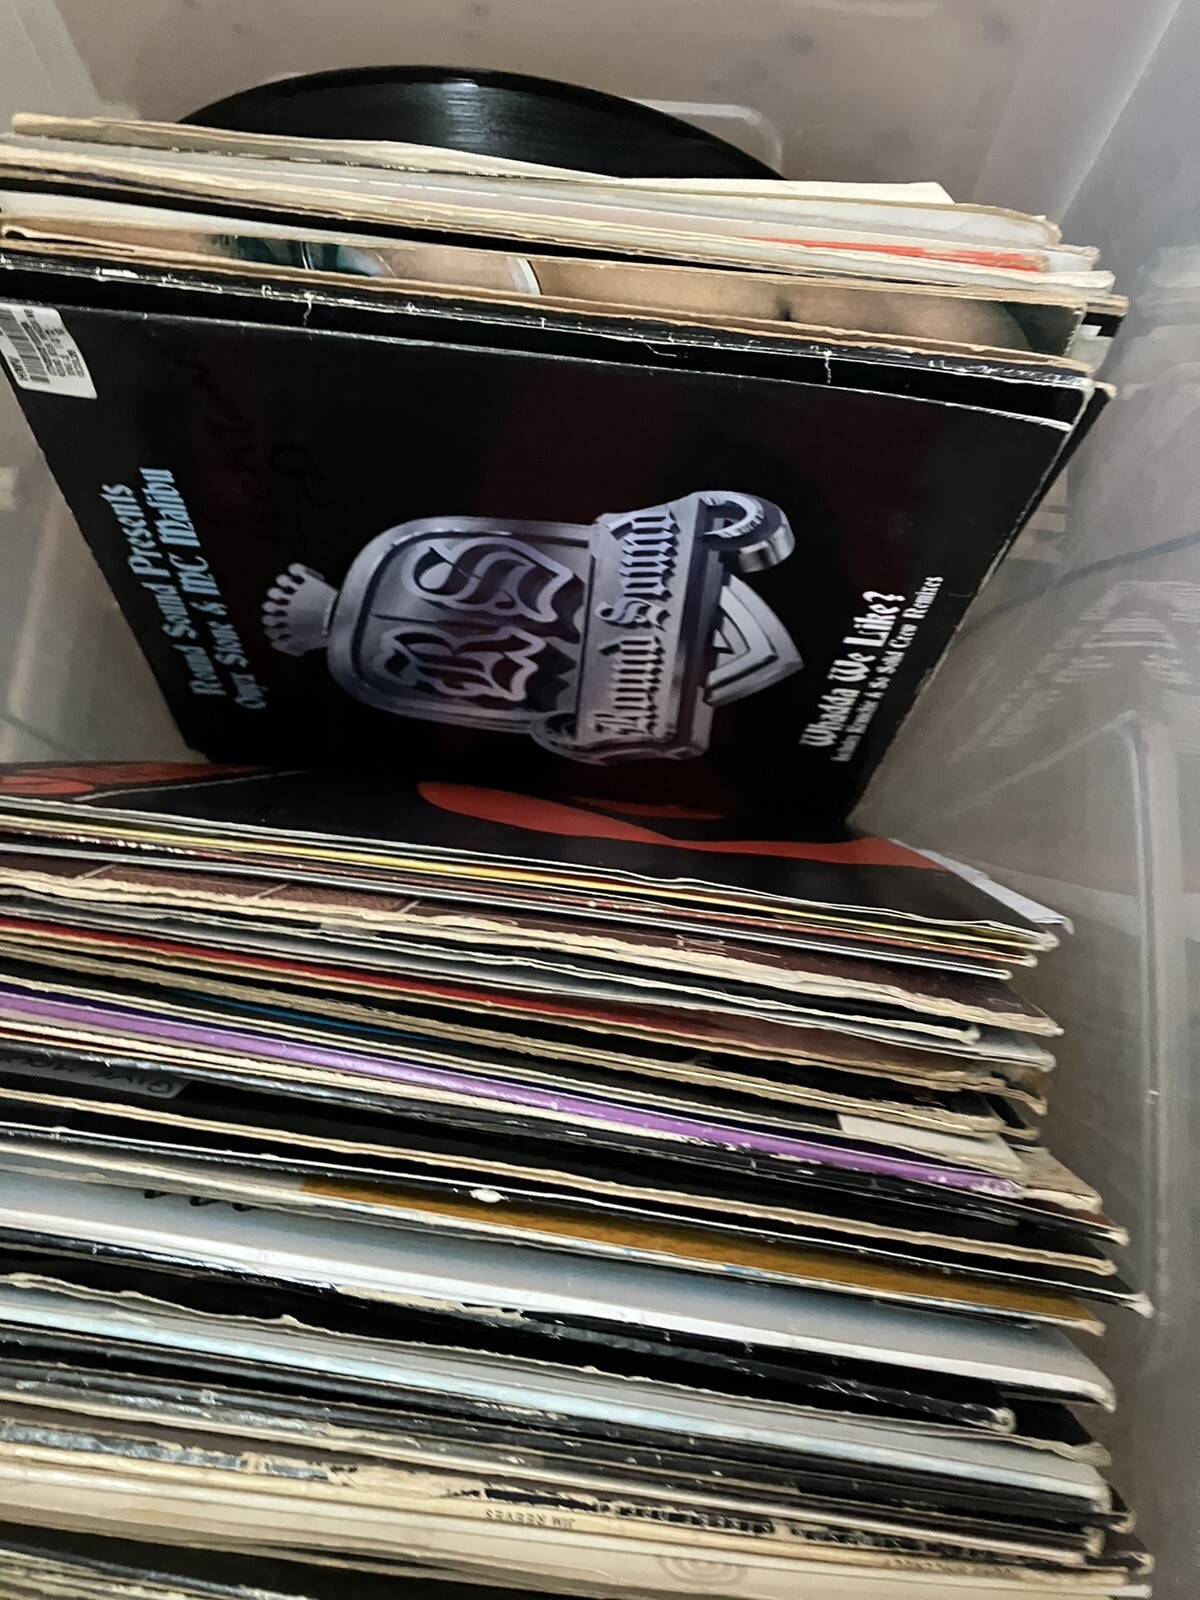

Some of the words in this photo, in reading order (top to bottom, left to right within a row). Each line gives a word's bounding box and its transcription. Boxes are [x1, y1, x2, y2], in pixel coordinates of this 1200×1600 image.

[98, 484, 171, 578] Presents
[138, 467, 201, 547] Malibu
[167, 551, 221, 597] MC
[594, 509, 680, 631] Sound
[902, 576, 944, 620] Remixes
[140, 581, 199, 640] Sound
[190, 600, 229, 616] &
[842, 590, 906, 647] Like?
[171, 644, 227, 696] Round
[206, 620, 250, 668] Stone
[826, 652, 876, 682] We
[586, 635, 666, 736] Round
[798, 687, 861, 747] Whadda
